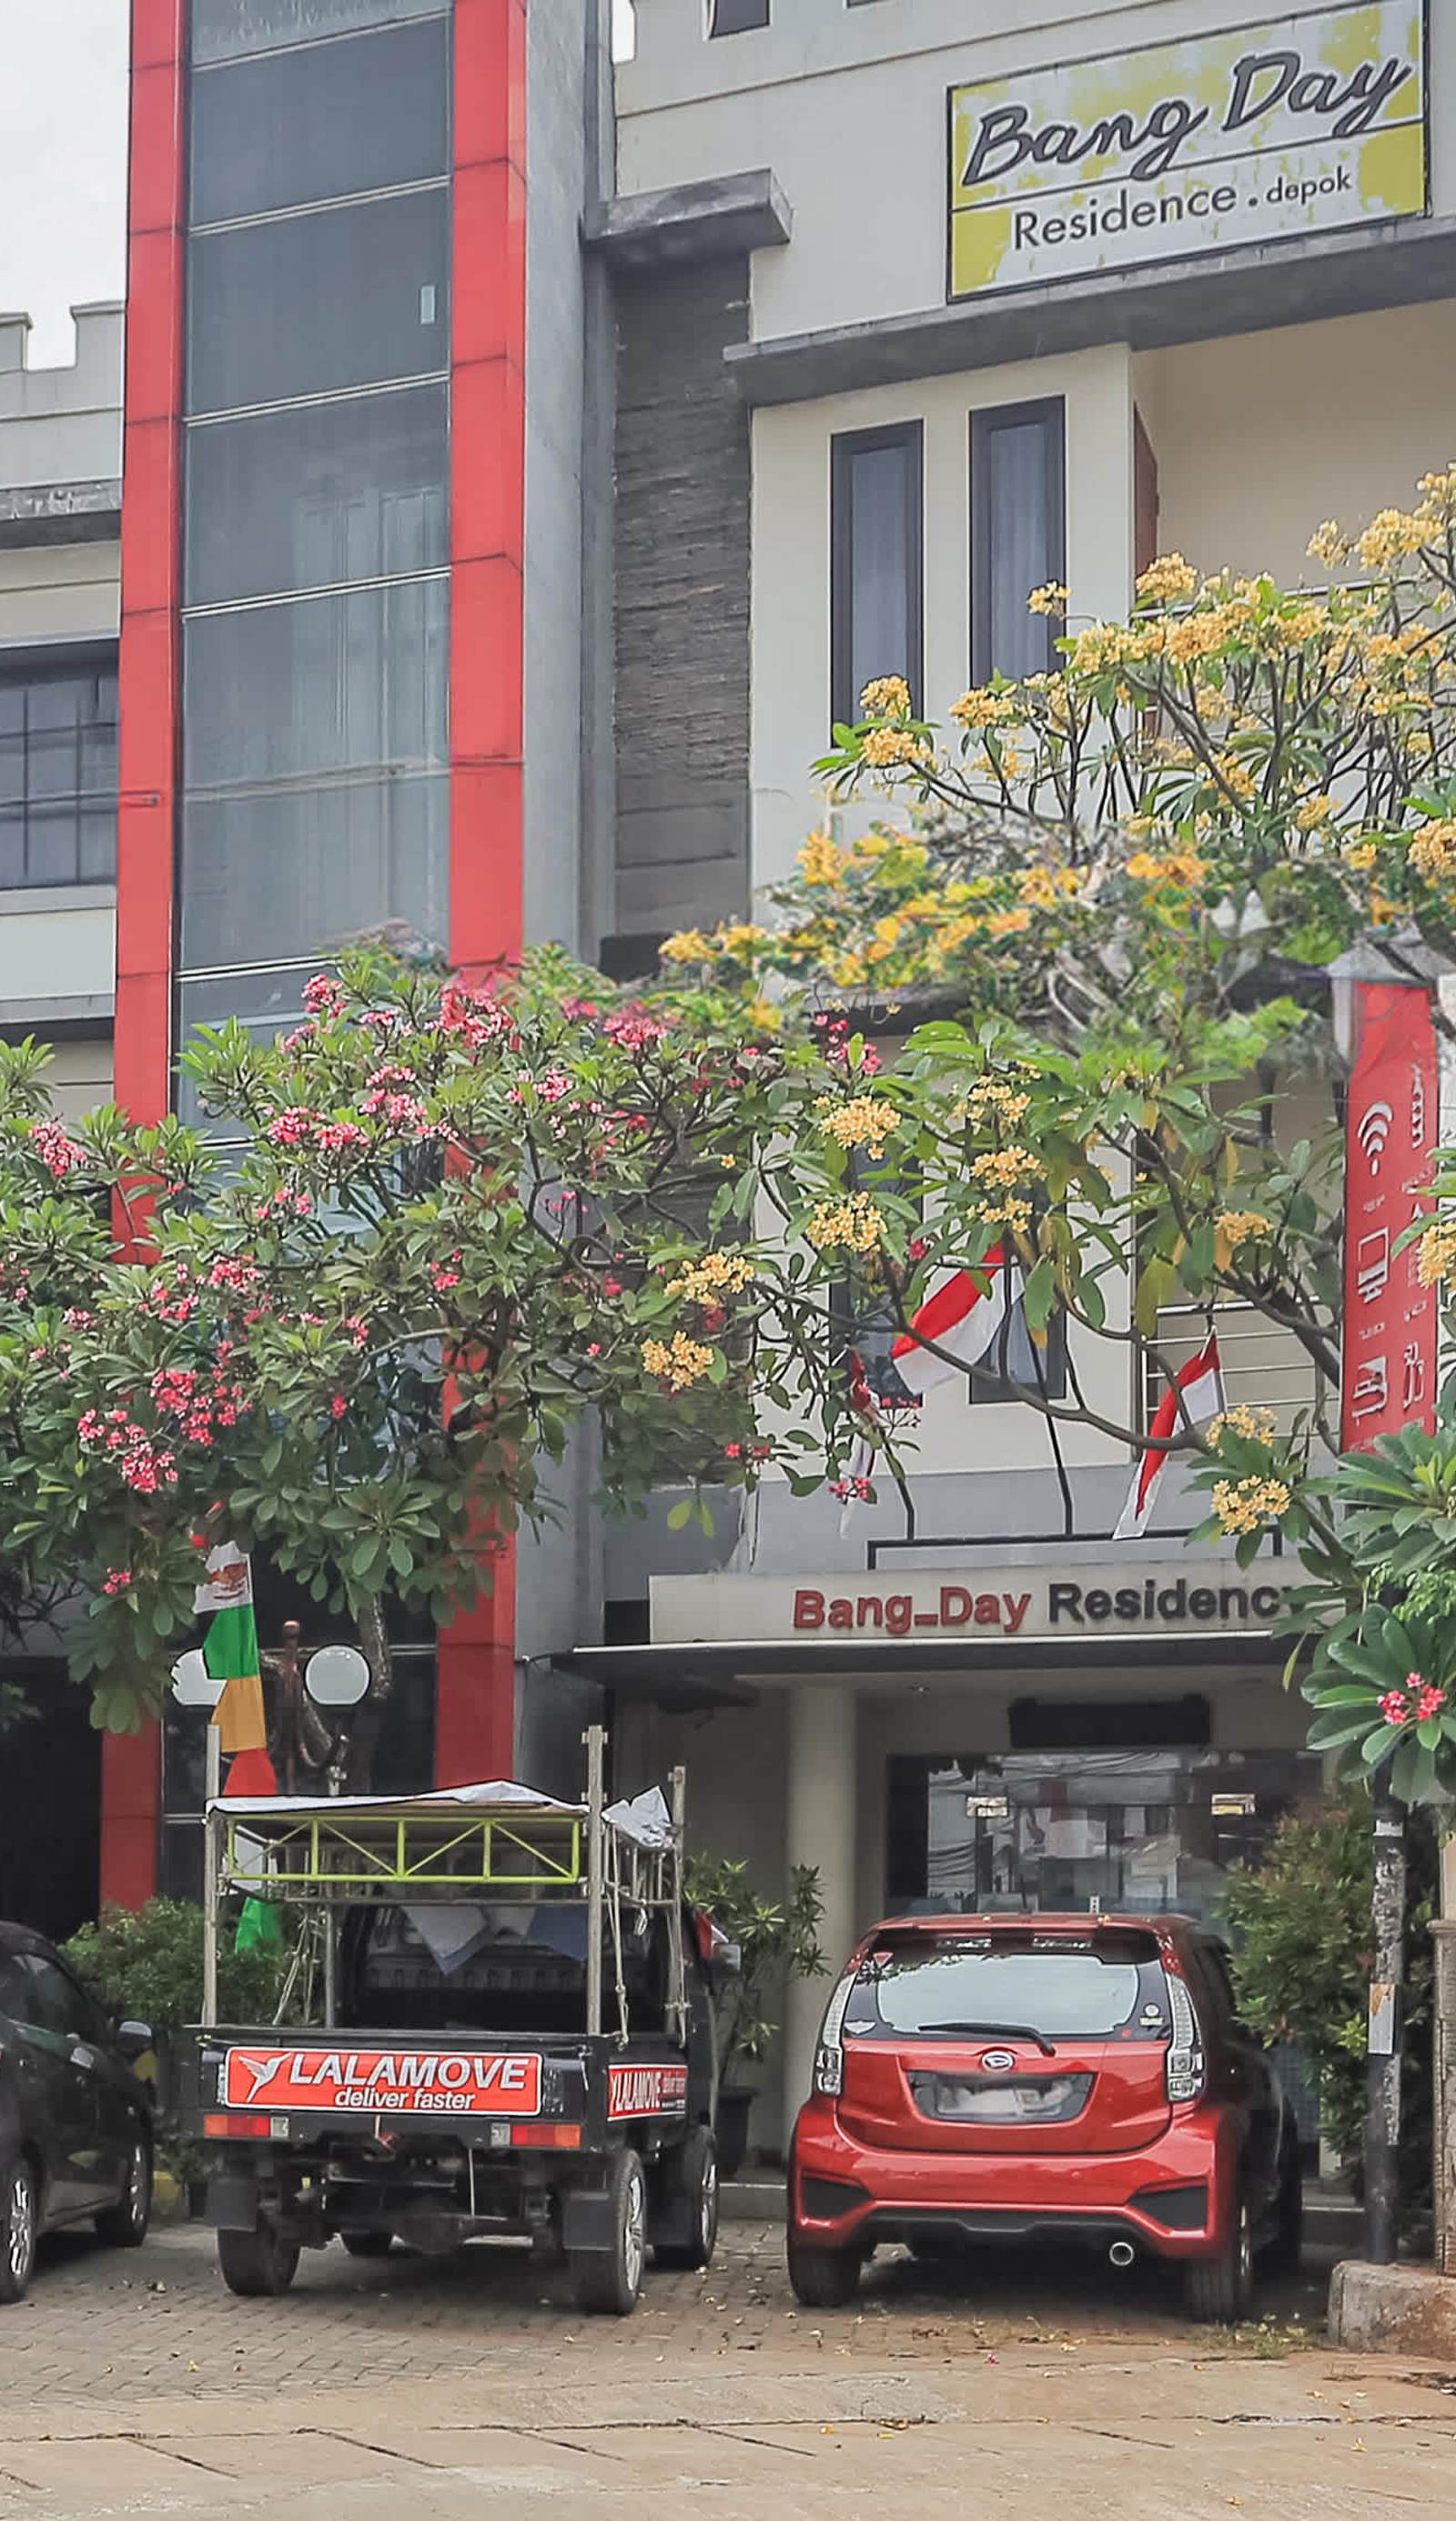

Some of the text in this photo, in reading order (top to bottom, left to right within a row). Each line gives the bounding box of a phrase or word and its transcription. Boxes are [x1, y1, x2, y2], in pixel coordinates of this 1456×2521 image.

[961, 50, 1412, 187] Bang Day
[1014, 185, 1237, 250] Residence
[793, 1585, 1033, 1635] Bang_Day
[289, 2053, 529, 2090] LALAMOVE
[335, 2086, 476, 2110] deliver faster
